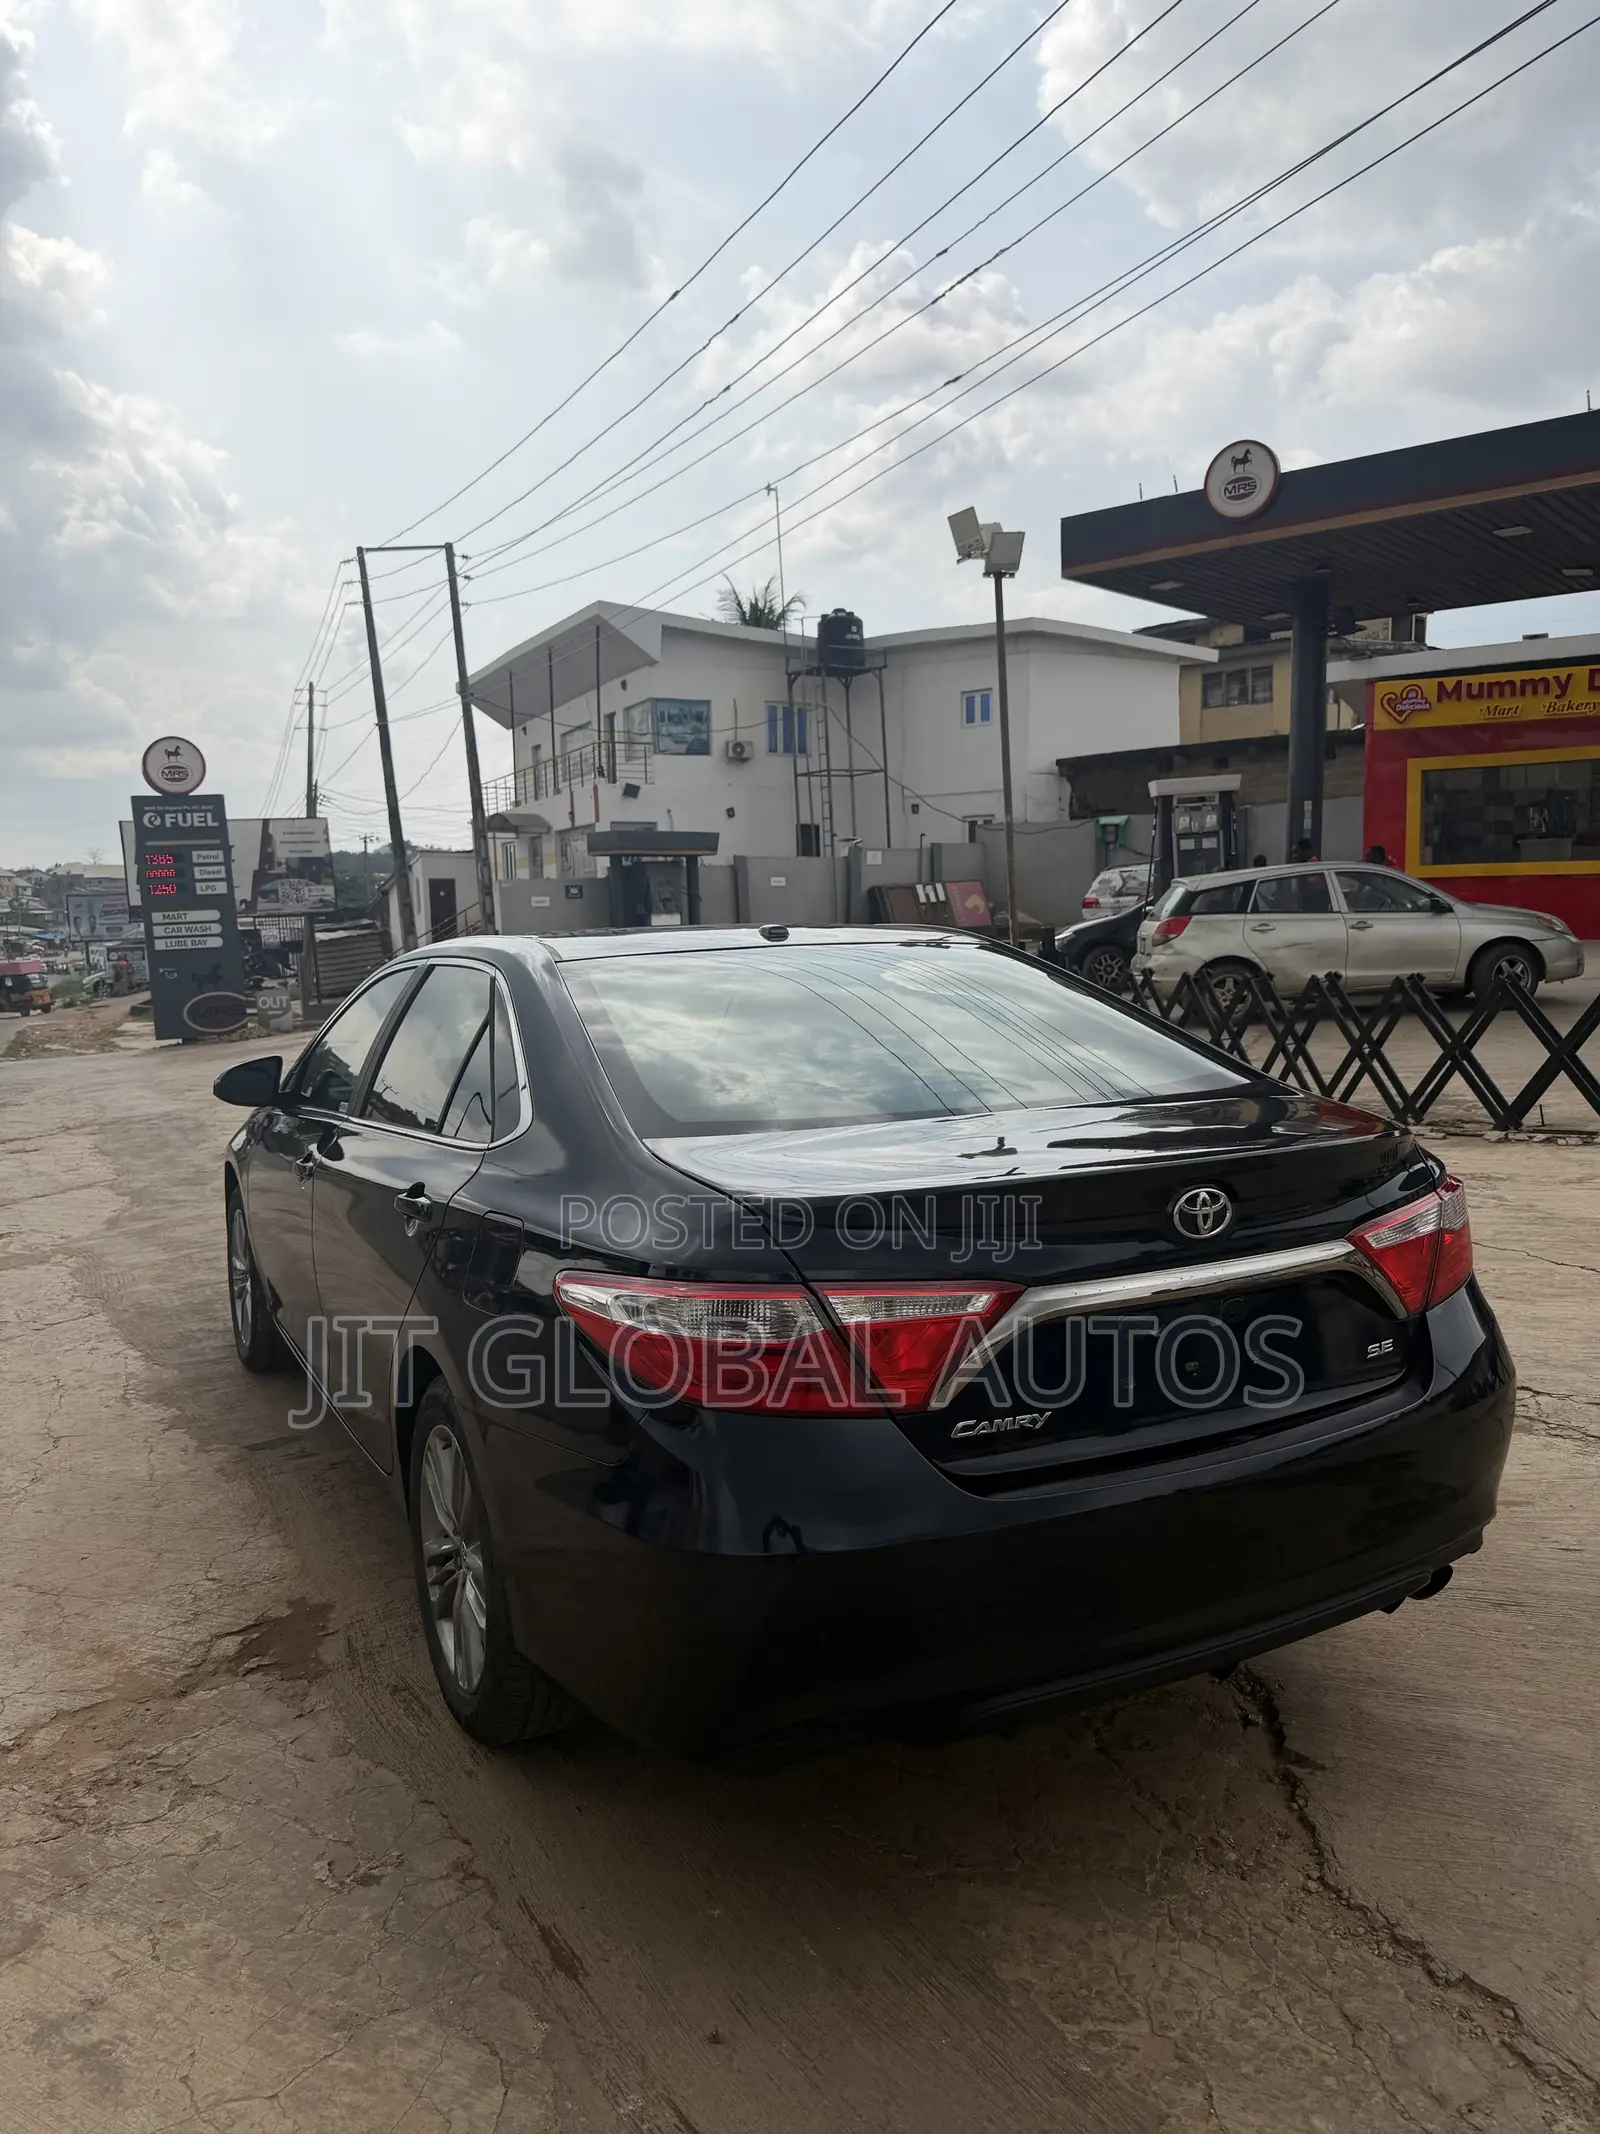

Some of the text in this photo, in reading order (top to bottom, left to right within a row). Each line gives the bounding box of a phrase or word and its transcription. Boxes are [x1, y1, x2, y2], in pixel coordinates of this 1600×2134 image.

[1223, 480, 1258, 497] MRS
[1436, 672, 1574, 703] Mummy
[1483, 700, 1600, 717] Mart Bakery
[164, 811, 219, 828] FUEL
[197, 852, 220, 861] Petrol
[199, 868, 222, 877] Diesel
[200, 885, 217, 893] LPG
[162, 912, 189, 921] MART
[163, 924, 212, 935] CAR WASH
[165, 938, 209, 948] LUBE BAY
[258, 995, 290, 1009] OUT
[1366, 1338, 1394, 1360] SE
[950, 1411, 1052, 1439] CAMRY
